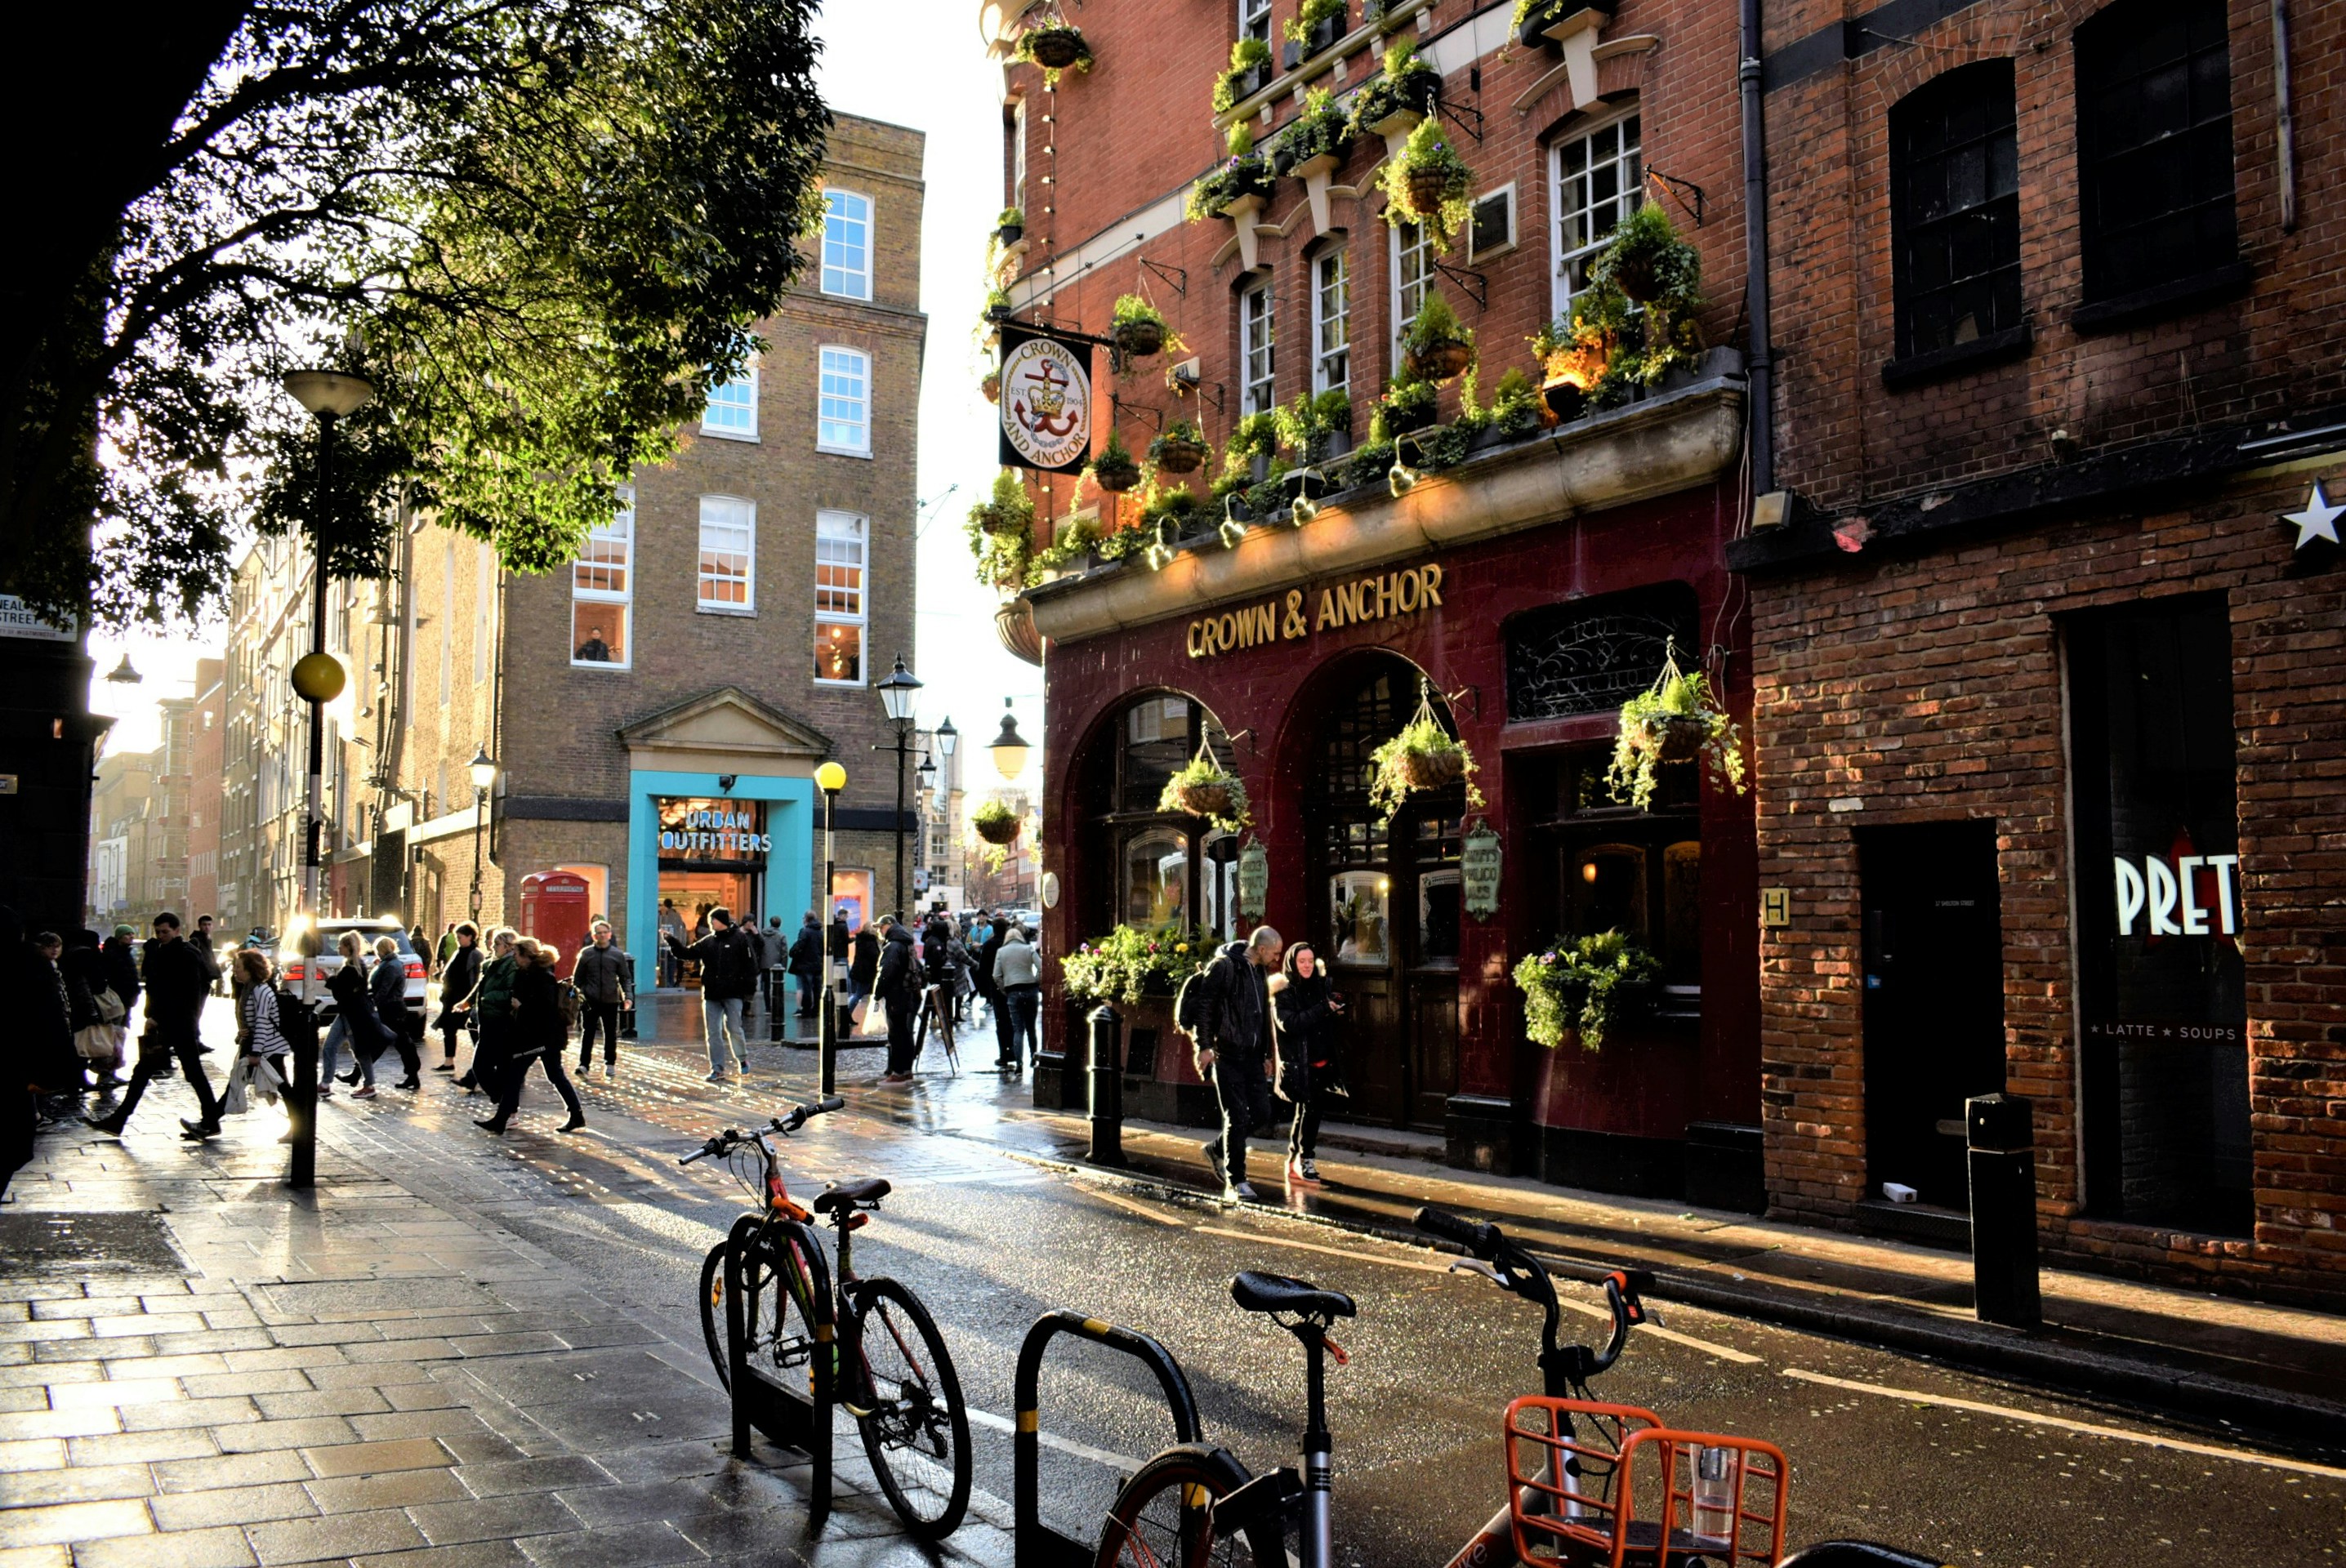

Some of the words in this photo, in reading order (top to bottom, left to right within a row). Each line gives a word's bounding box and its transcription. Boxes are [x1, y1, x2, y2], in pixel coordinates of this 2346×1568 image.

[1020, 341, 1073, 368] CROWN
[1010, 387, 1027, 397] EST.
[1067, 397, 1082, 407] 1904
[1005, 420, 1030, 452] AND
[1029, 432, 1086, 466] ANCHOR
[0, 612, 38, 625] TREET
[1187, 602, 1276, 658] CROWN
[1282, 589, 1307, 639] &
[1315, 564, 1443, 631] ANCHOR
[685, 810, 750, 830] URBAN
[661, 831, 773, 852] OUTFITTERS
[1765, 893, 1784, 921] H
[2114, 854, 2238, 936] PRET
[2106, 1023, 2156, 1036] LATTE
[2179, 1027, 2236, 1040] SOUPS
